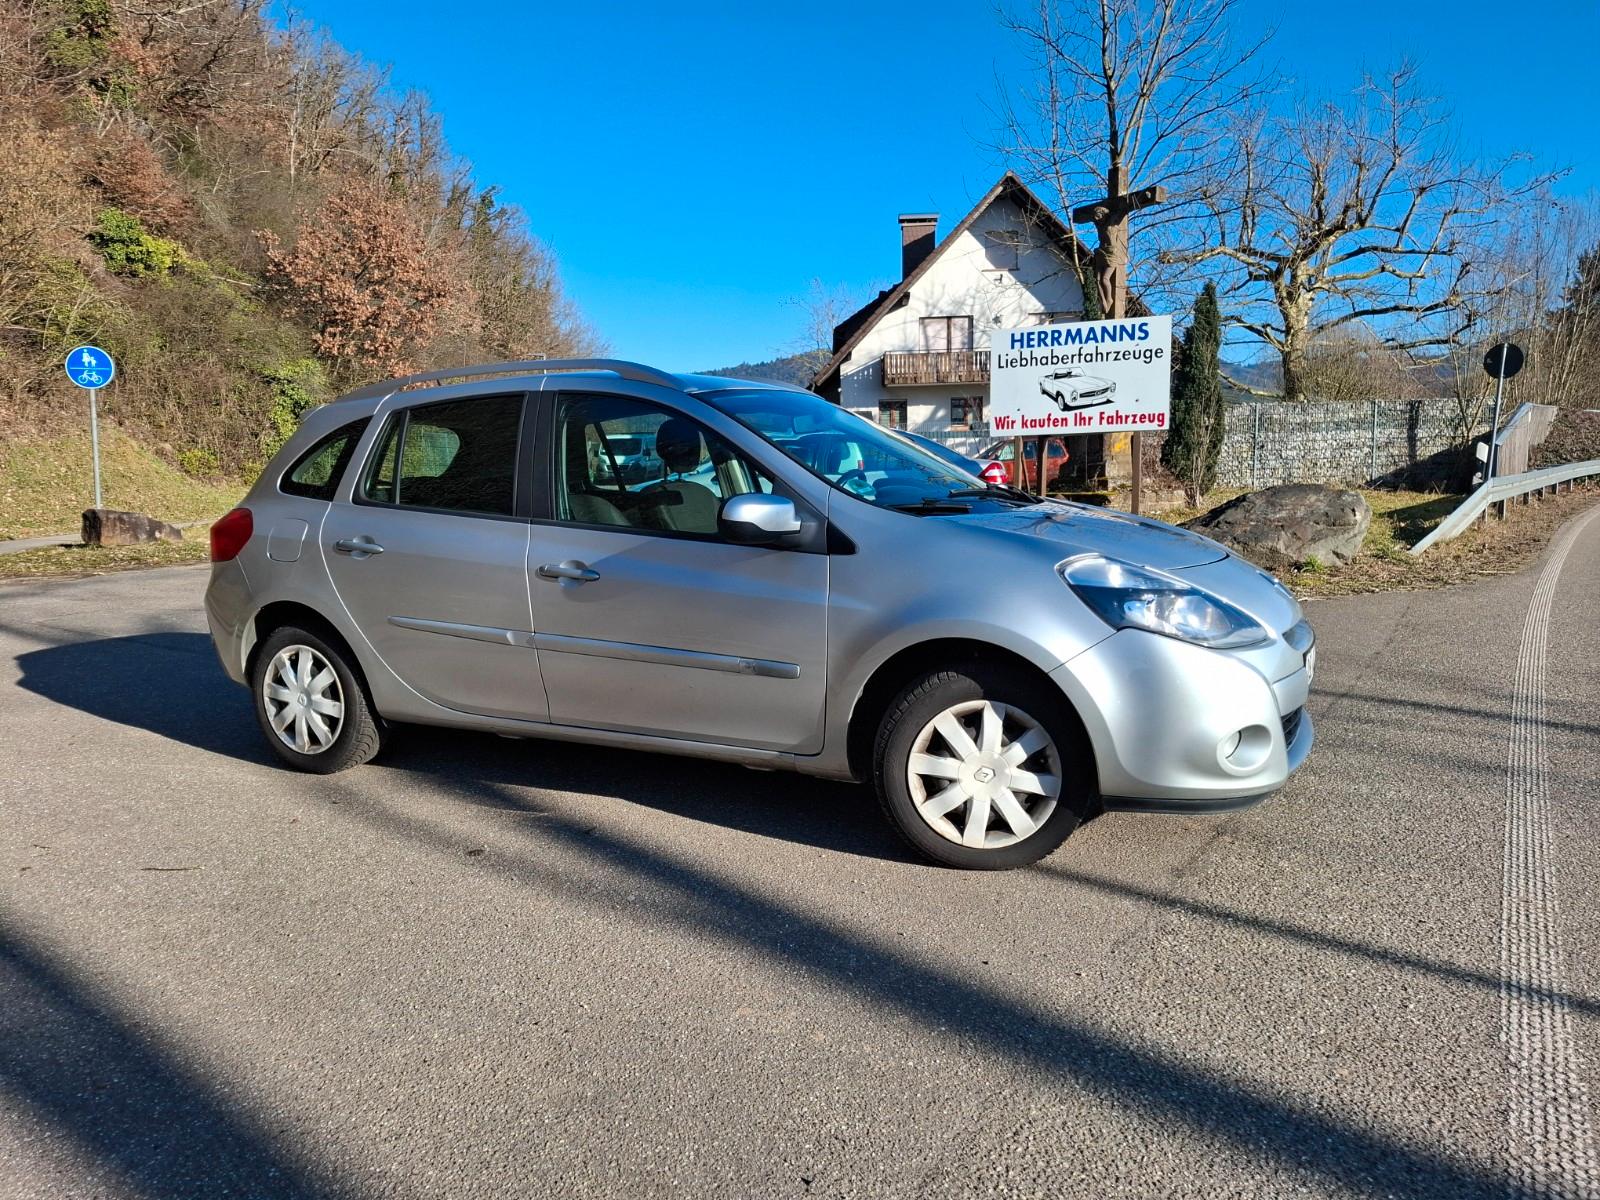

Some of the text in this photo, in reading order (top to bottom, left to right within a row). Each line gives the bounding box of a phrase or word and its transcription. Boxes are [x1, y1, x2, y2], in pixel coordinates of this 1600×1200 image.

[1010, 322, 1150, 350] HERRMANNS
[997, 346, 1164, 369] Liebhaberfahrzeuge
[994, 409, 1165, 430] Wir kaufen Ihr Fahrzeug
